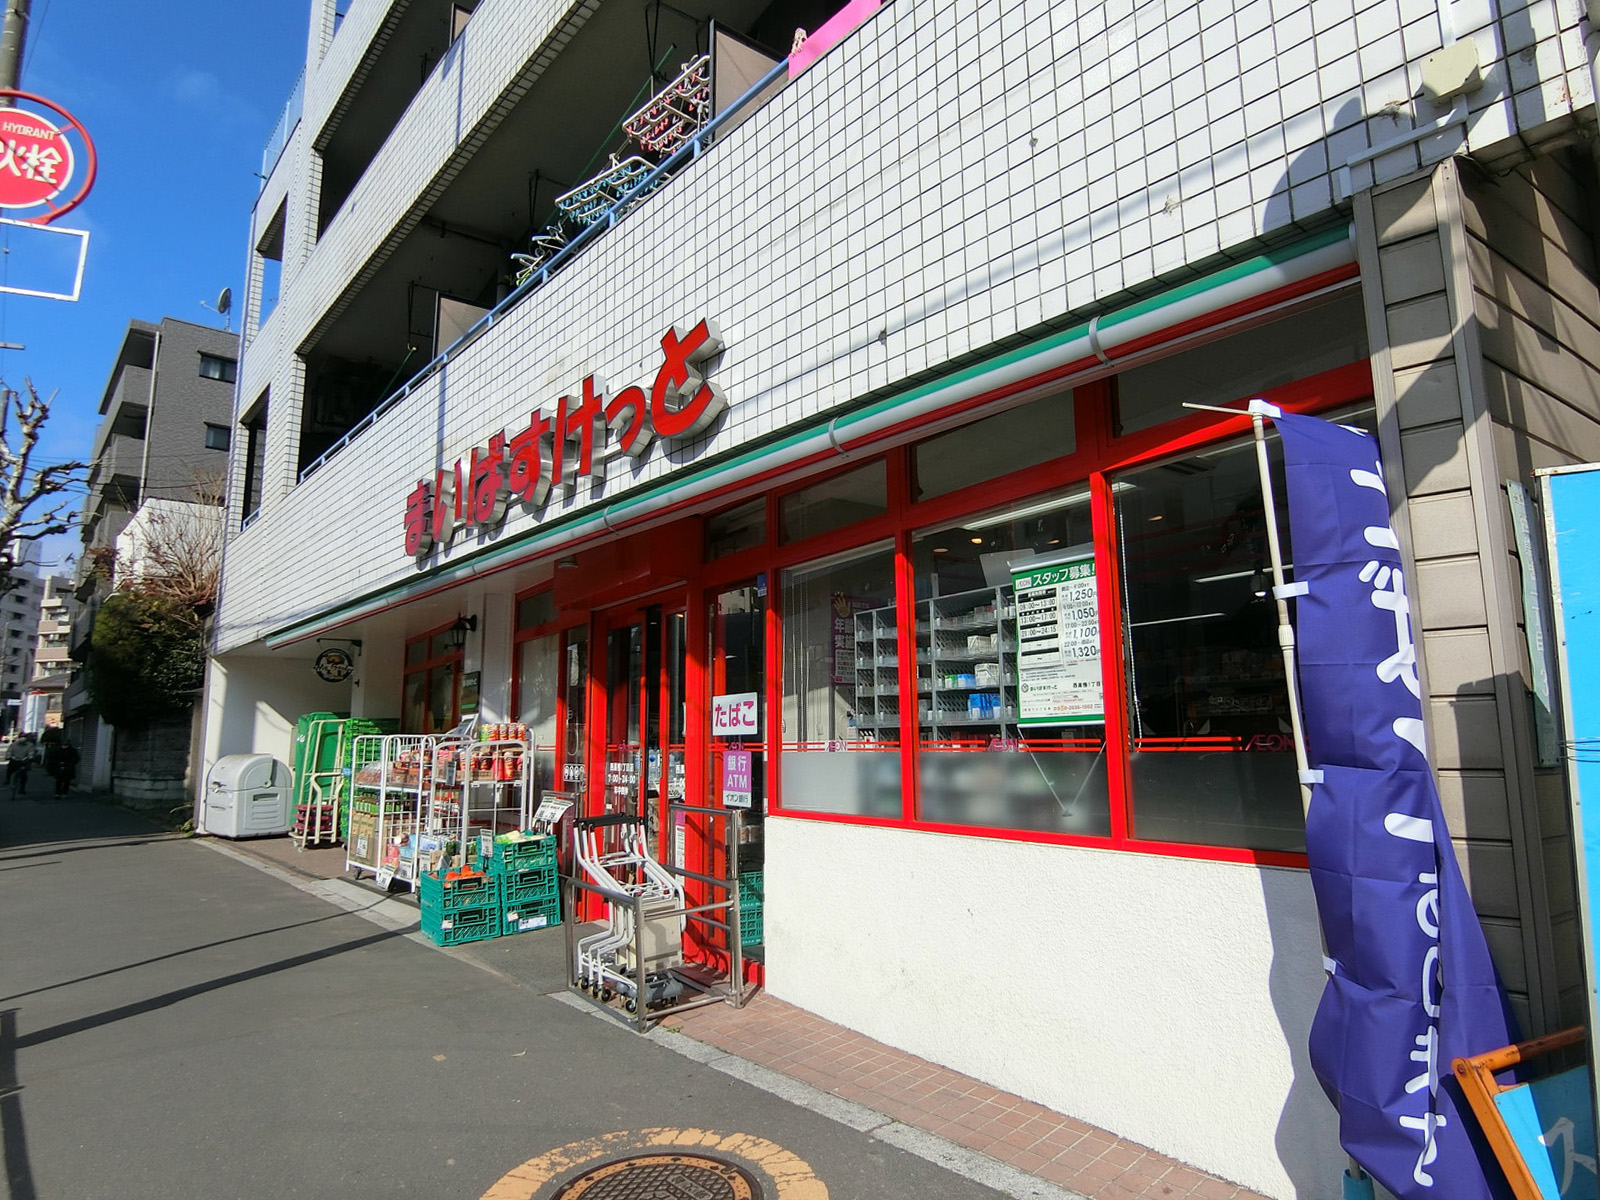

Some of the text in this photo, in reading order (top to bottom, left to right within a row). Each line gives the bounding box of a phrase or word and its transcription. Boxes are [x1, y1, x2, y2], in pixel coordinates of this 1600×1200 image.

[3, 121, 56, 140] HYDRANT
[404, 318, 719, 556] まいばすけっと
[715, 700, 755, 727] たばこ
[727, 755, 747, 772] 銀行
[727, 774, 748, 789] ATM
